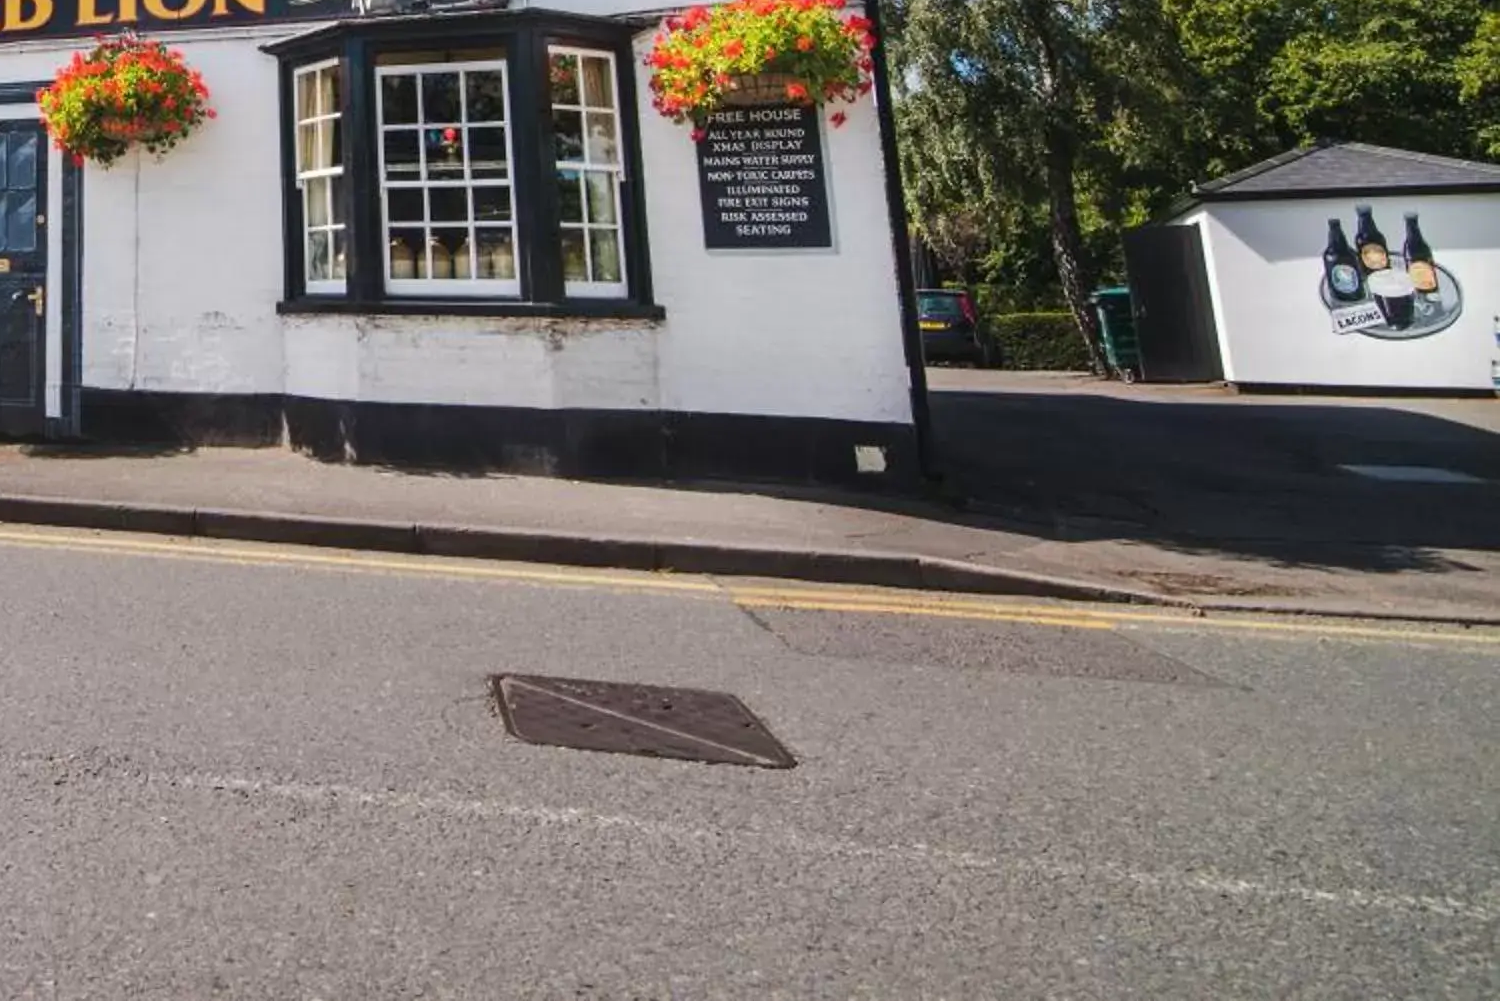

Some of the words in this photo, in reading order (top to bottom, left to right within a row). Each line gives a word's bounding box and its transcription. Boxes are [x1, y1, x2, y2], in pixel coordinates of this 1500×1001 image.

[707, 110, 744, 124] FREE
[749, 108, 802, 122] HOUSE
[708, 130, 728, 140] ALL
[730, 129, 761, 139] YEAR
[764, 128, 805, 138] ROUND
[713, 141, 746, 152] XMAS
[751, 140, 803, 151] DISPLAY
[703, 156, 740, 167] MAINS
[742, 155, 779, 166] WATER
[781, 154, 815, 165] SUPPLY
[727, 185, 801, 195] ILLUMINATED
[718, 198, 742, 207] FIRE
[745, 198, 768, 207] EXIT
[771, 197, 810, 207] SIGNS
[721, 212, 748, 222] RISK
[751, 212, 807, 221] ASSESSED
[736, 225, 791, 236] SEATING
